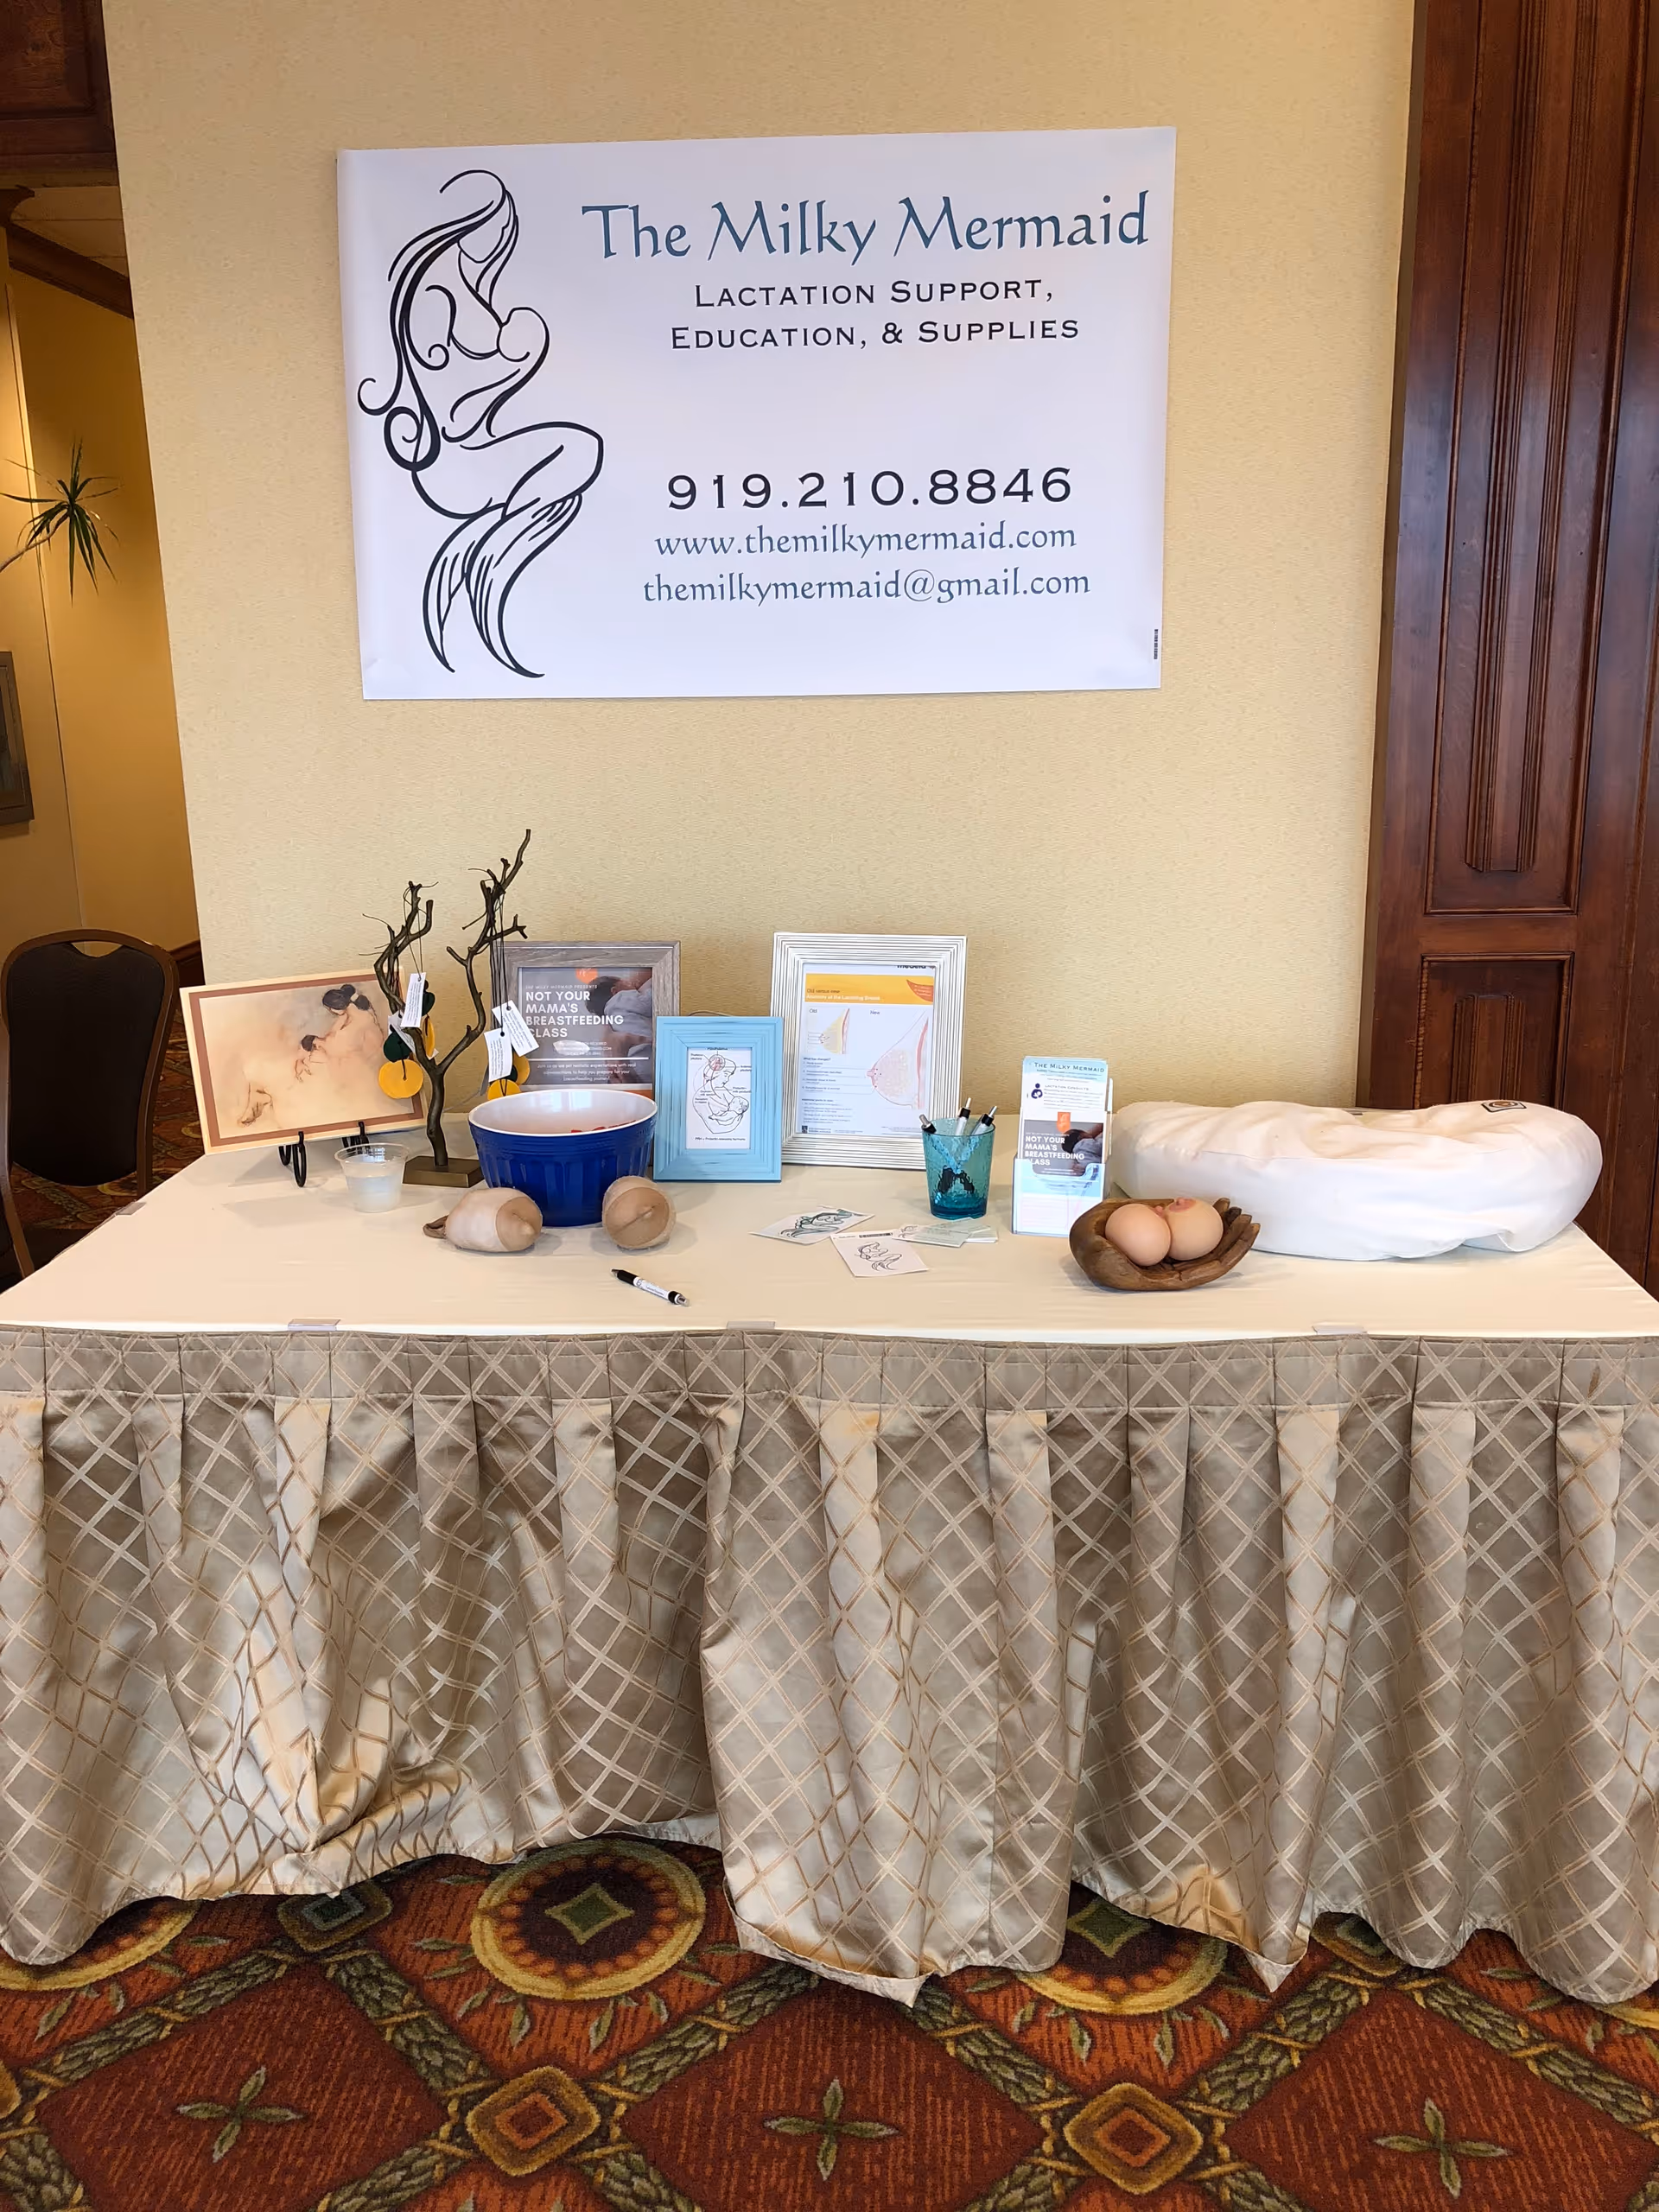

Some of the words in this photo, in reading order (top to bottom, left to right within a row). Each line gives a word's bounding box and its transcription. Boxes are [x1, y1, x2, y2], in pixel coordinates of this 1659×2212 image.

[582, 205, 691, 259] The
[708, 200, 876, 266] Milky
[893, 190, 1149, 257] Mermaid
[695, 284, 874, 308] LACTATION
[890, 278, 1053, 303] SUPPORT,
[671, 326, 868, 350] EDUCATION,
[881, 321, 903, 345] &
[918, 319, 1078, 343] SUPPLIES
[667, 467, 1071, 511] 919.210.8846
[654, 519, 1077, 559] www.themilkymermaid.com
[643, 566, 1090, 607] themilkymermaid@gmail.com
[525, 991, 551, 1001] NOT
[556, 990, 591, 1001] YOUR
[525, 1002, 579, 1014] MAMA'S
[525, 1014, 624, 1026] BREASTFEEDING
[1025, 1142, 1058, 1151] MAMA'S
[1025, 1150, 1085, 1160] BREASTFEEDING
